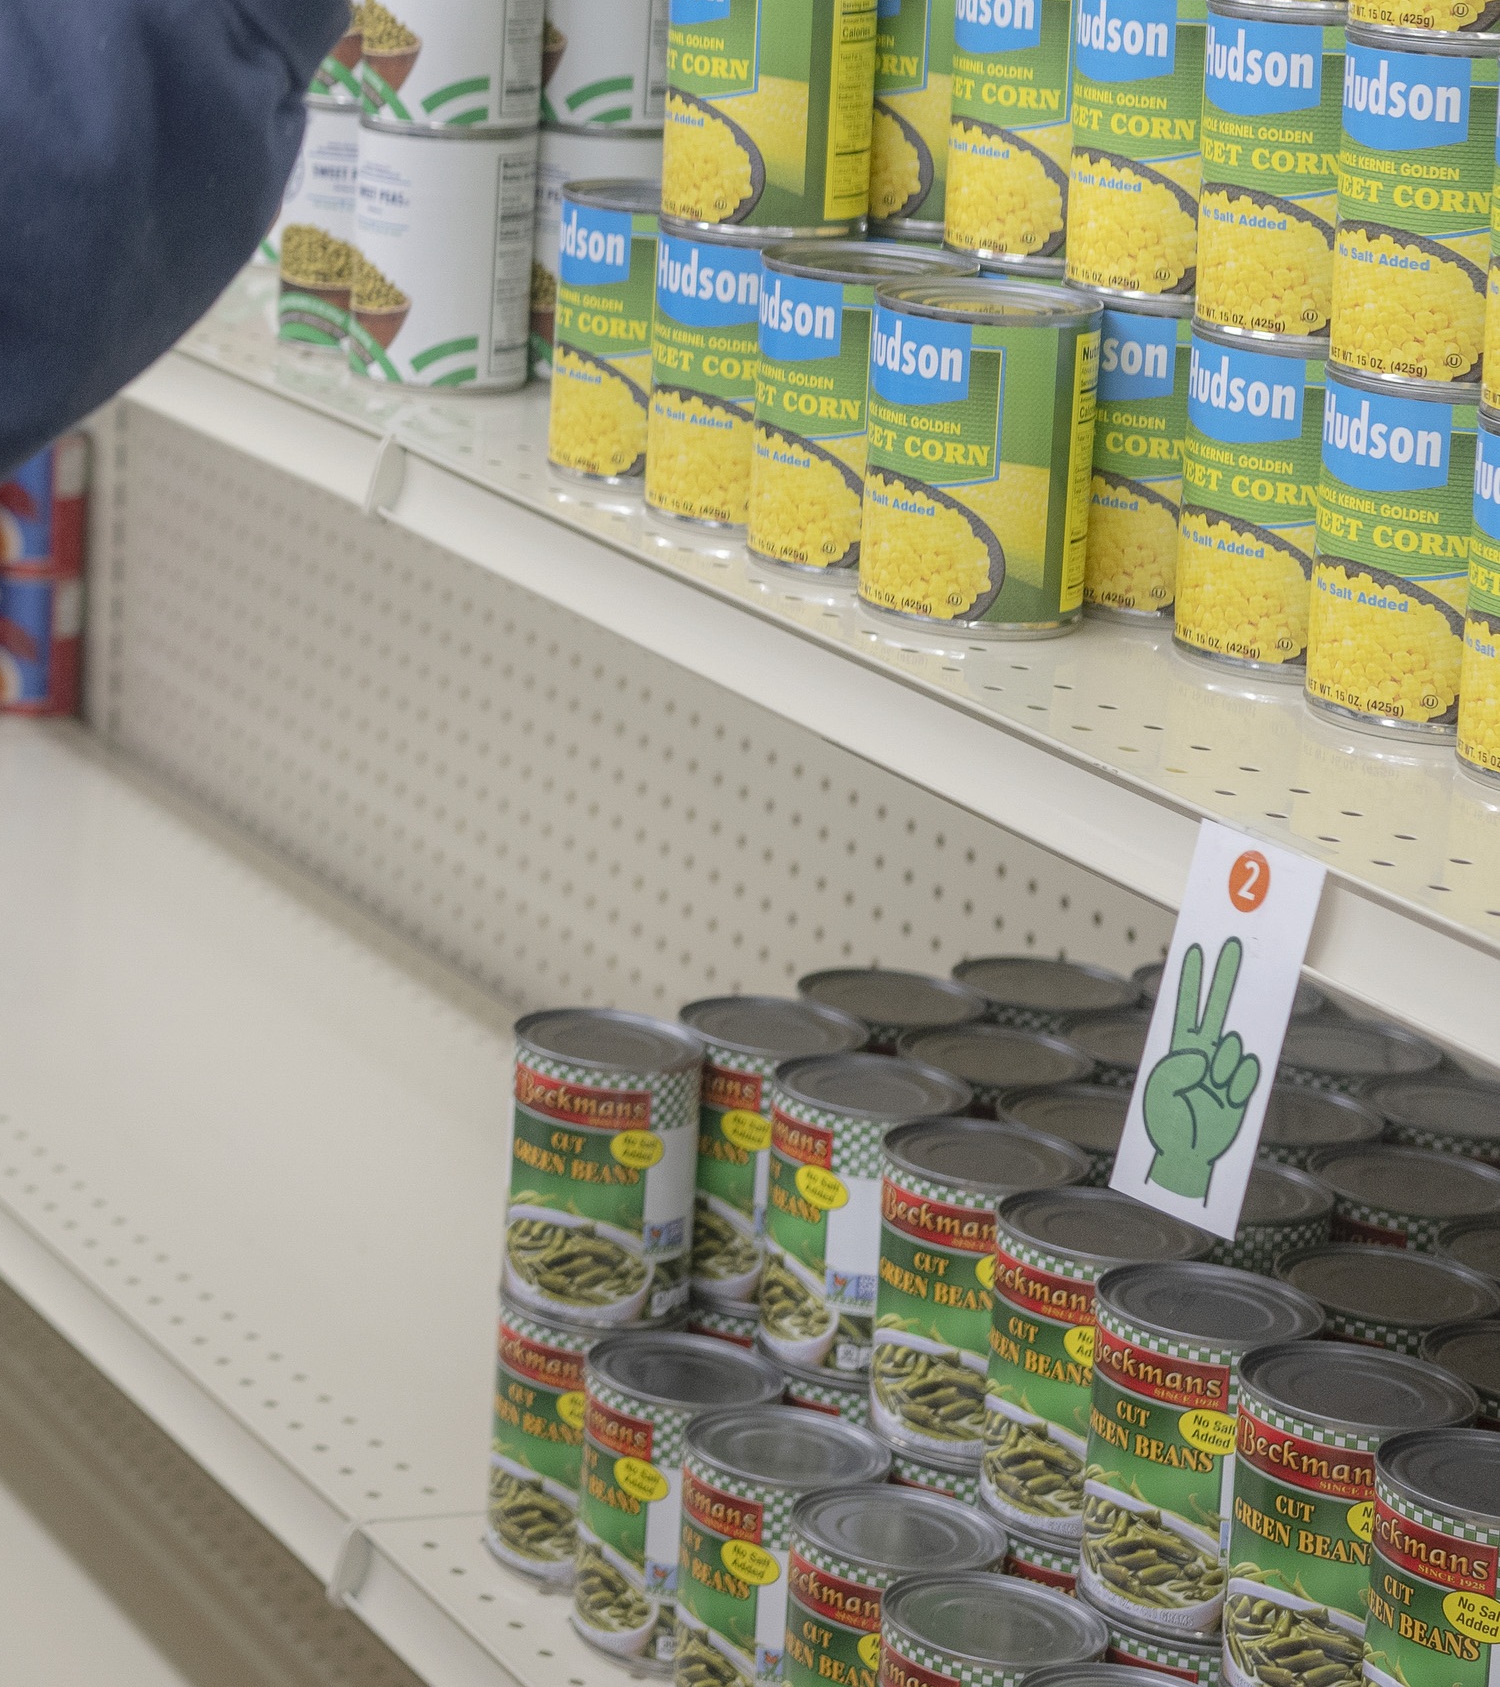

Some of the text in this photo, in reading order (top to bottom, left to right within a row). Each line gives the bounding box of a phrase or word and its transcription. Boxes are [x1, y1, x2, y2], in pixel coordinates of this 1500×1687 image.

[1399, 12, 1435, 29] (425g)
[1206, 24, 1314, 90] Hudson
[1342, 53, 1461, 123] Hudson
[1219, 121, 1314, 144] KERNEL GOLDEN
[1251, 148, 1341, 176] CORN
[1358, 156, 1460, 181] KERNEL GOLDEN
[1393, 184, 1492, 214] CORN
[1213, 208, 1287, 231] Salt Added
[658, 240, 760, 306] Hudson
[1351, 248, 1431, 271] Salt Added
[1251, 316, 1286, 333] (425g)
[1357, 351, 1428, 378] 15 OZ. (425g)
[1189, 346, 1296, 421] Hudson
[1323, 390, 1442, 469] Hudson
[1201, 444, 1293, 475] KERNEL GOLDEN
[1231, 474, 1319, 507] CORN
[1337, 492, 1439, 525] KERNEL GOLDEN
[1192, 531, 1265, 560] Salt Added
[1372, 522, 1470, 558] CORN
[1316, 577, 1408, 614] No Salt Added
[1225, 641, 1260, 659] (425g)
[1335, 688, 1404, 718] 15 OZ. (425g)
[1238, 860, 1260, 901] 2
[882, 1186, 998, 1241] Beckman
[913, 1251, 949, 1277] CUT
[1008, 1316, 1039, 1344] CUT
[1022, 1347, 1093, 1388] BEANS
[1154, 1388, 1191, 1401] SINCE
[1116, 1399, 1151, 1429] CUT
[1192, 1415, 1209, 1428] No
[1134, 1434, 1214, 1474] BEANS
[1191, 1430, 1231, 1449] Added
[1239, 1416, 1374, 1487] Beckman
[1319, 1480, 1360, 1496] SINCE
[1234, 1497, 1291, 1548] GREEN
[1275, 1494, 1315, 1523] CUT
[1374, 1512, 1490, 1581] eckmans
[1383, 1575, 1414, 1607] CUT
[1418, 1564, 1486, 1590] SINCE 1928
[1457, 1595, 1500, 1620] No Sal
[1399, 1616, 1481, 1661] BEANS
[1456, 1612, 1499, 1636] Added
